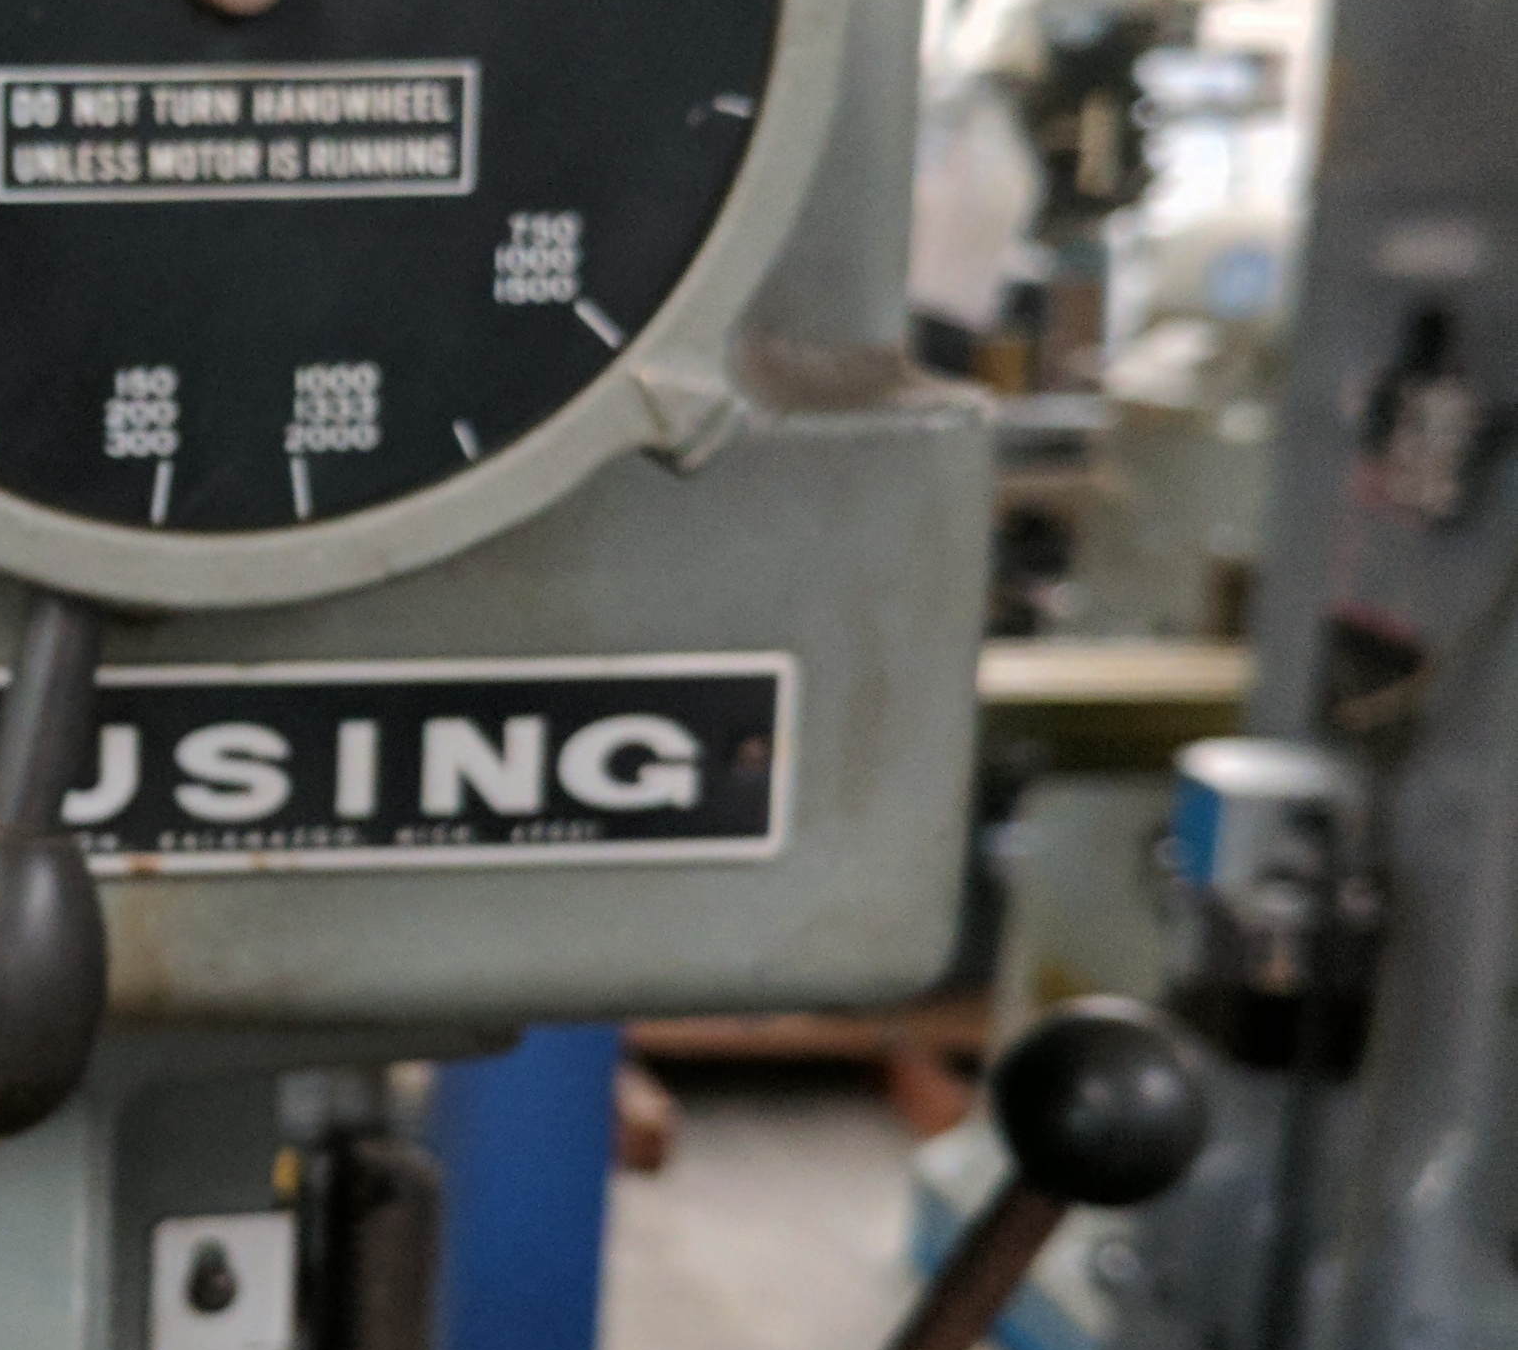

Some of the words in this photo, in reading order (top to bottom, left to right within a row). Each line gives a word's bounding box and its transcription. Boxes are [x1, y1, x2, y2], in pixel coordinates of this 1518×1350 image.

[11, 84, 60, 128] DO
[72, 84, 138, 128] NOT
[152, 83, 240, 127] TURN
[252, 79, 451, 125] HANDWHEEL
[12, 137, 142, 183] UNLESS
[148, 138, 261, 181] MOTOR
[269, 137, 302, 181] IS
[308, 133, 453, 180] RUNNING
